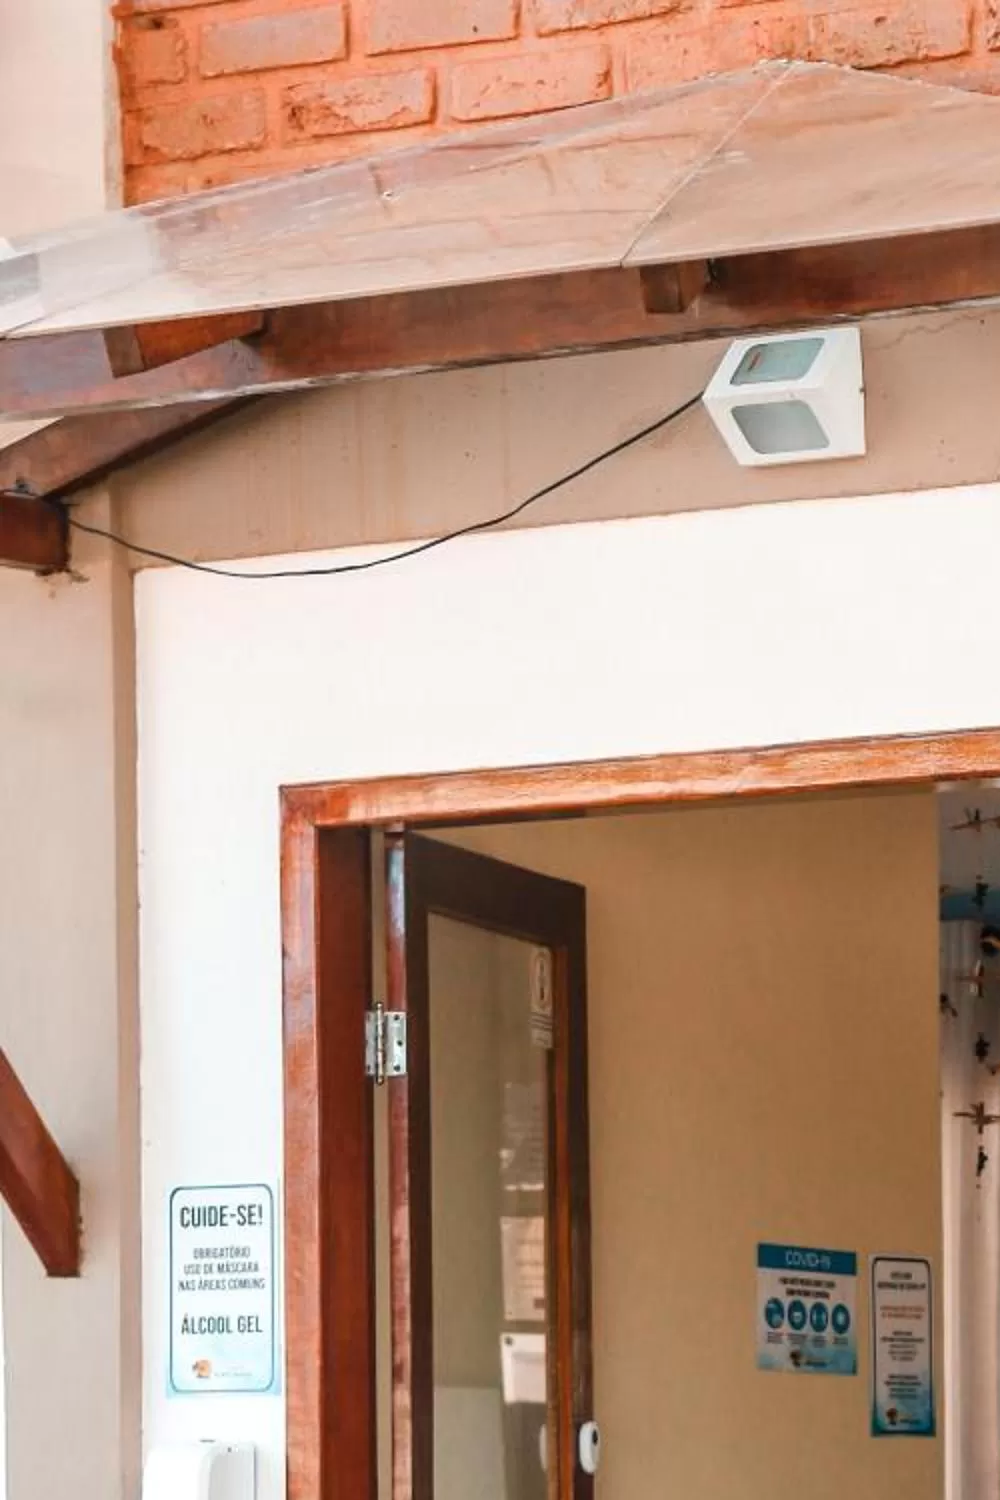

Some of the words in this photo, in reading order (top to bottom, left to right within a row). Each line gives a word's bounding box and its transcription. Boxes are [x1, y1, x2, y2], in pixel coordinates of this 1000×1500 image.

[179, 1204, 263, 1228] CUIDE-SE!
[183, 1264, 201, 1276] USO
[203, 1263, 214, 1275] DE
[178, 1279, 196, 1292] NAS
[181, 1313, 233, 1335] ÁLCOOL
[237, 1315, 264, 1333] GEL
